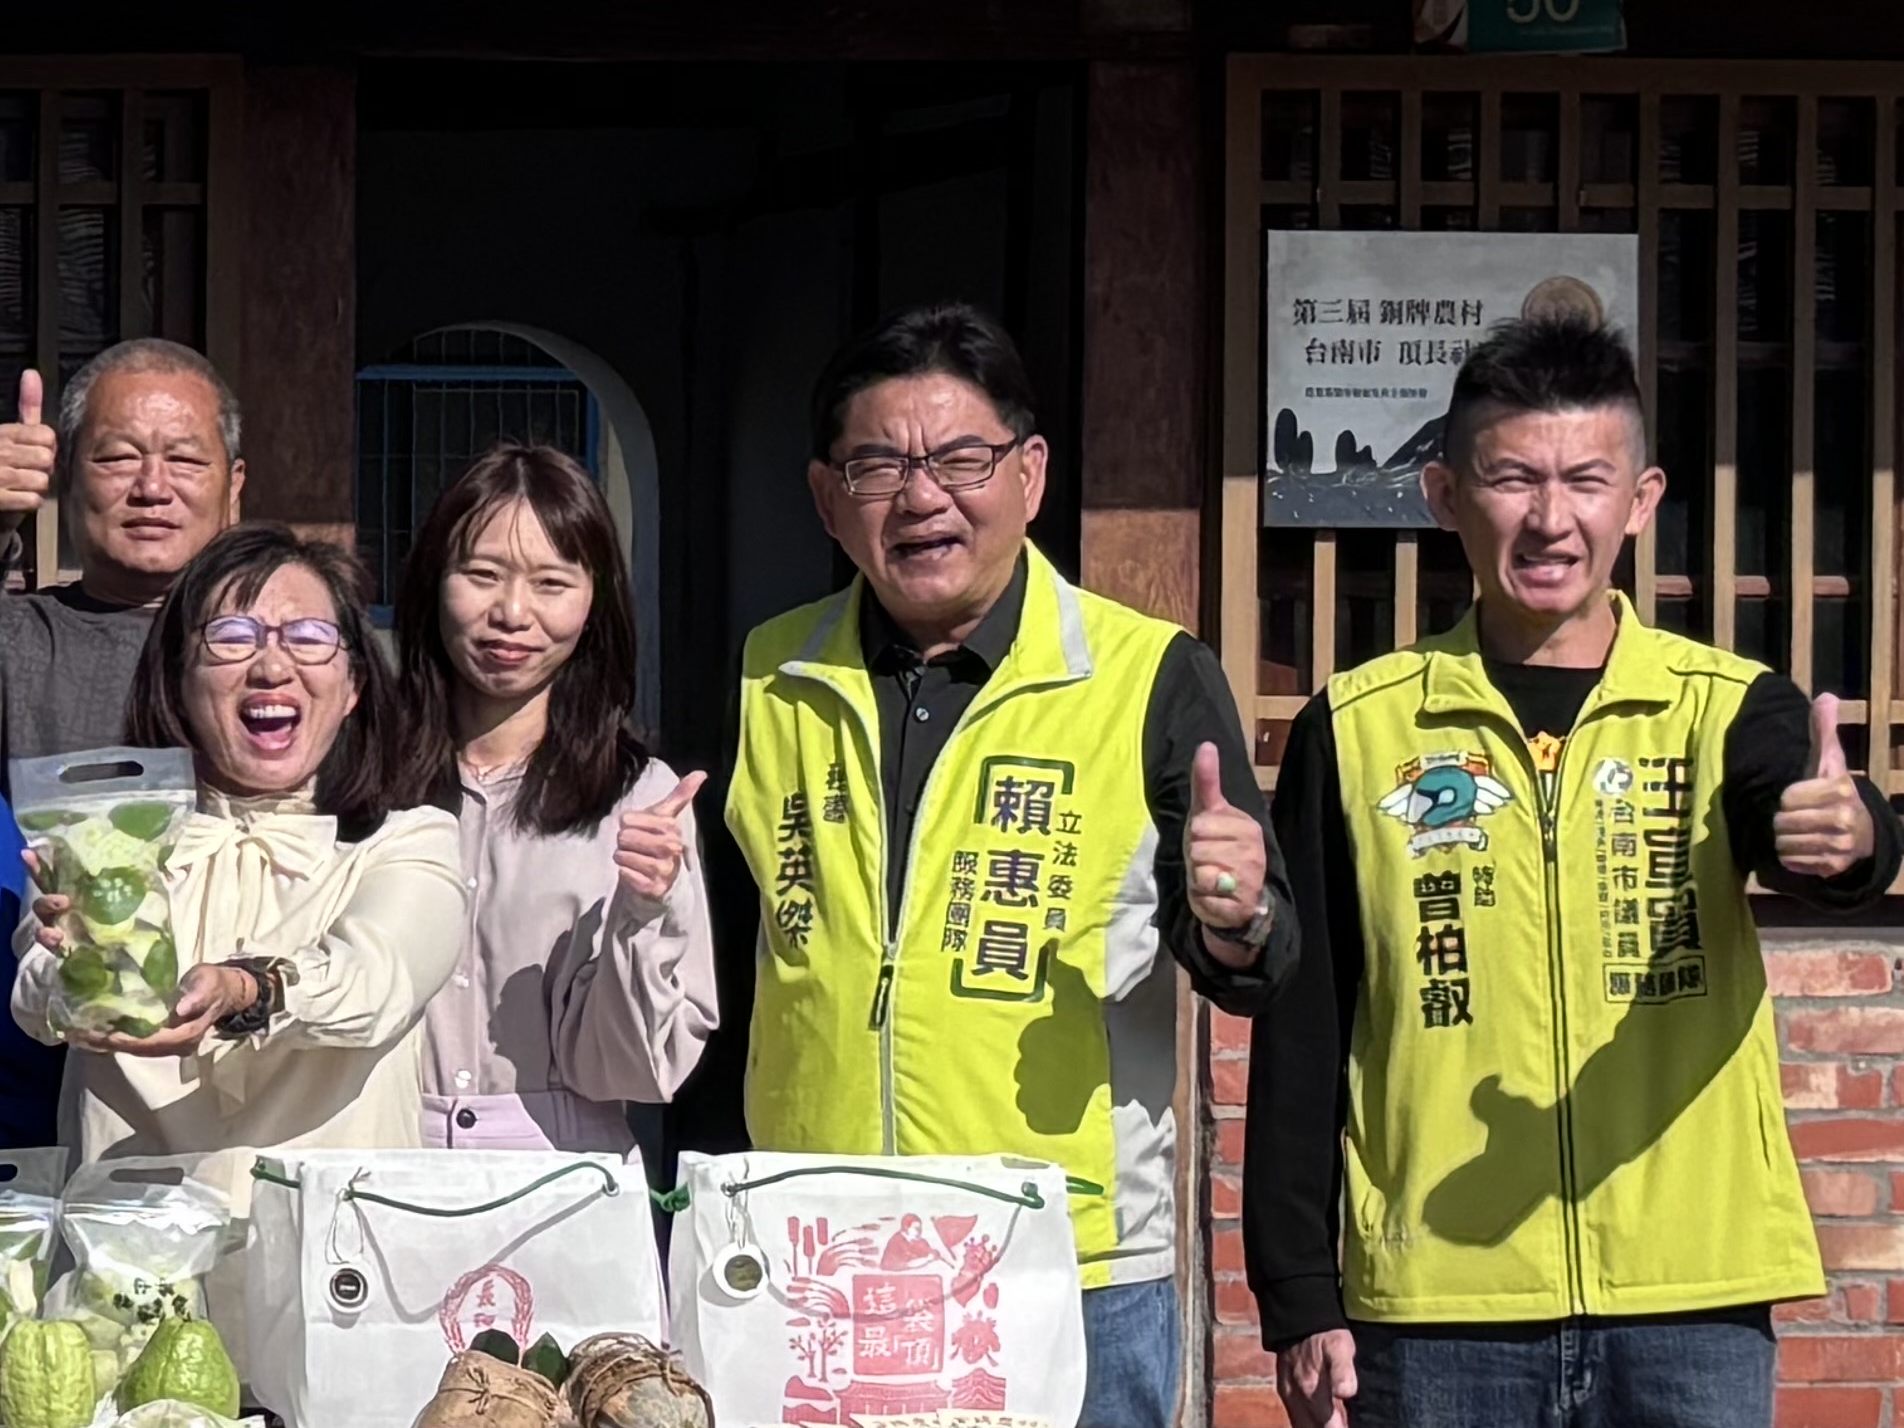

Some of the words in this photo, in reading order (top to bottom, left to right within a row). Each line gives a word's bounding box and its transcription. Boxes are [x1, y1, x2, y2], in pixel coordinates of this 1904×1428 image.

[1292, 298, 1371, 325] 第三屆
[1380, 298, 1484, 325] 銅牌農村
[1305, 337, 1382, 365] 台南市
[970, 775, 1056, 981] 賴惠員
[1042, 810, 1083, 933] 立法委員
[1610, 798, 1642, 959] 台南市議員
